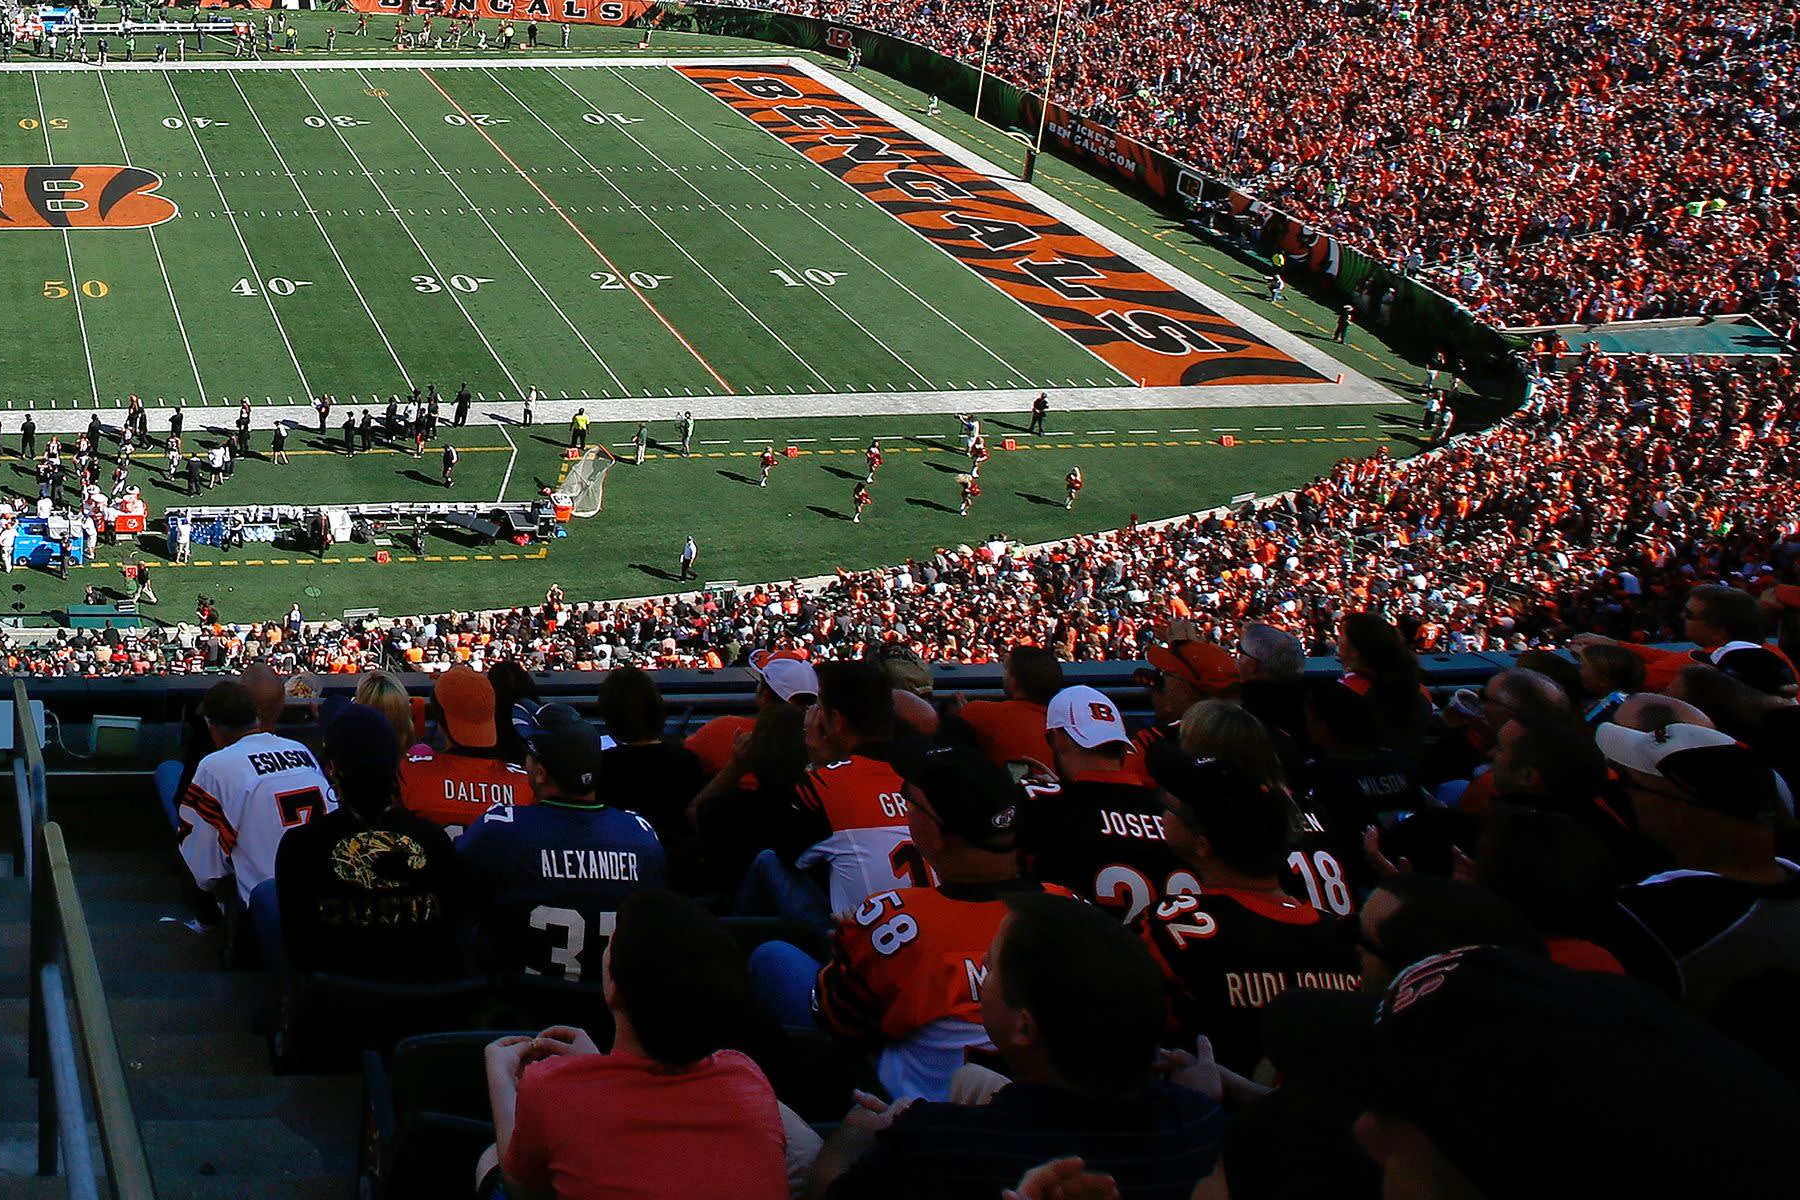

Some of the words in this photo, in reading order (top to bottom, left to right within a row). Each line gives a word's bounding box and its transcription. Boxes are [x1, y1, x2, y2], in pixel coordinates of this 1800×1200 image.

[726, 74, 1229, 357] BENGALS
[42, 279, 109, 299] 50
[230, 276, 297, 298] 40
[410, 273, 480, 294] 30
[588, 270, 661, 291] 20
[769, 267, 837, 287] 10
[248, 751, 316, 776] ESIASON
[443, 778, 515, 807] DALTON
[540, 848, 640, 882] ALEXANDER
[1287, 849, 1353, 916] 18
[855, 889, 919, 958] 58
[1156, 894, 1219, 951] 32
